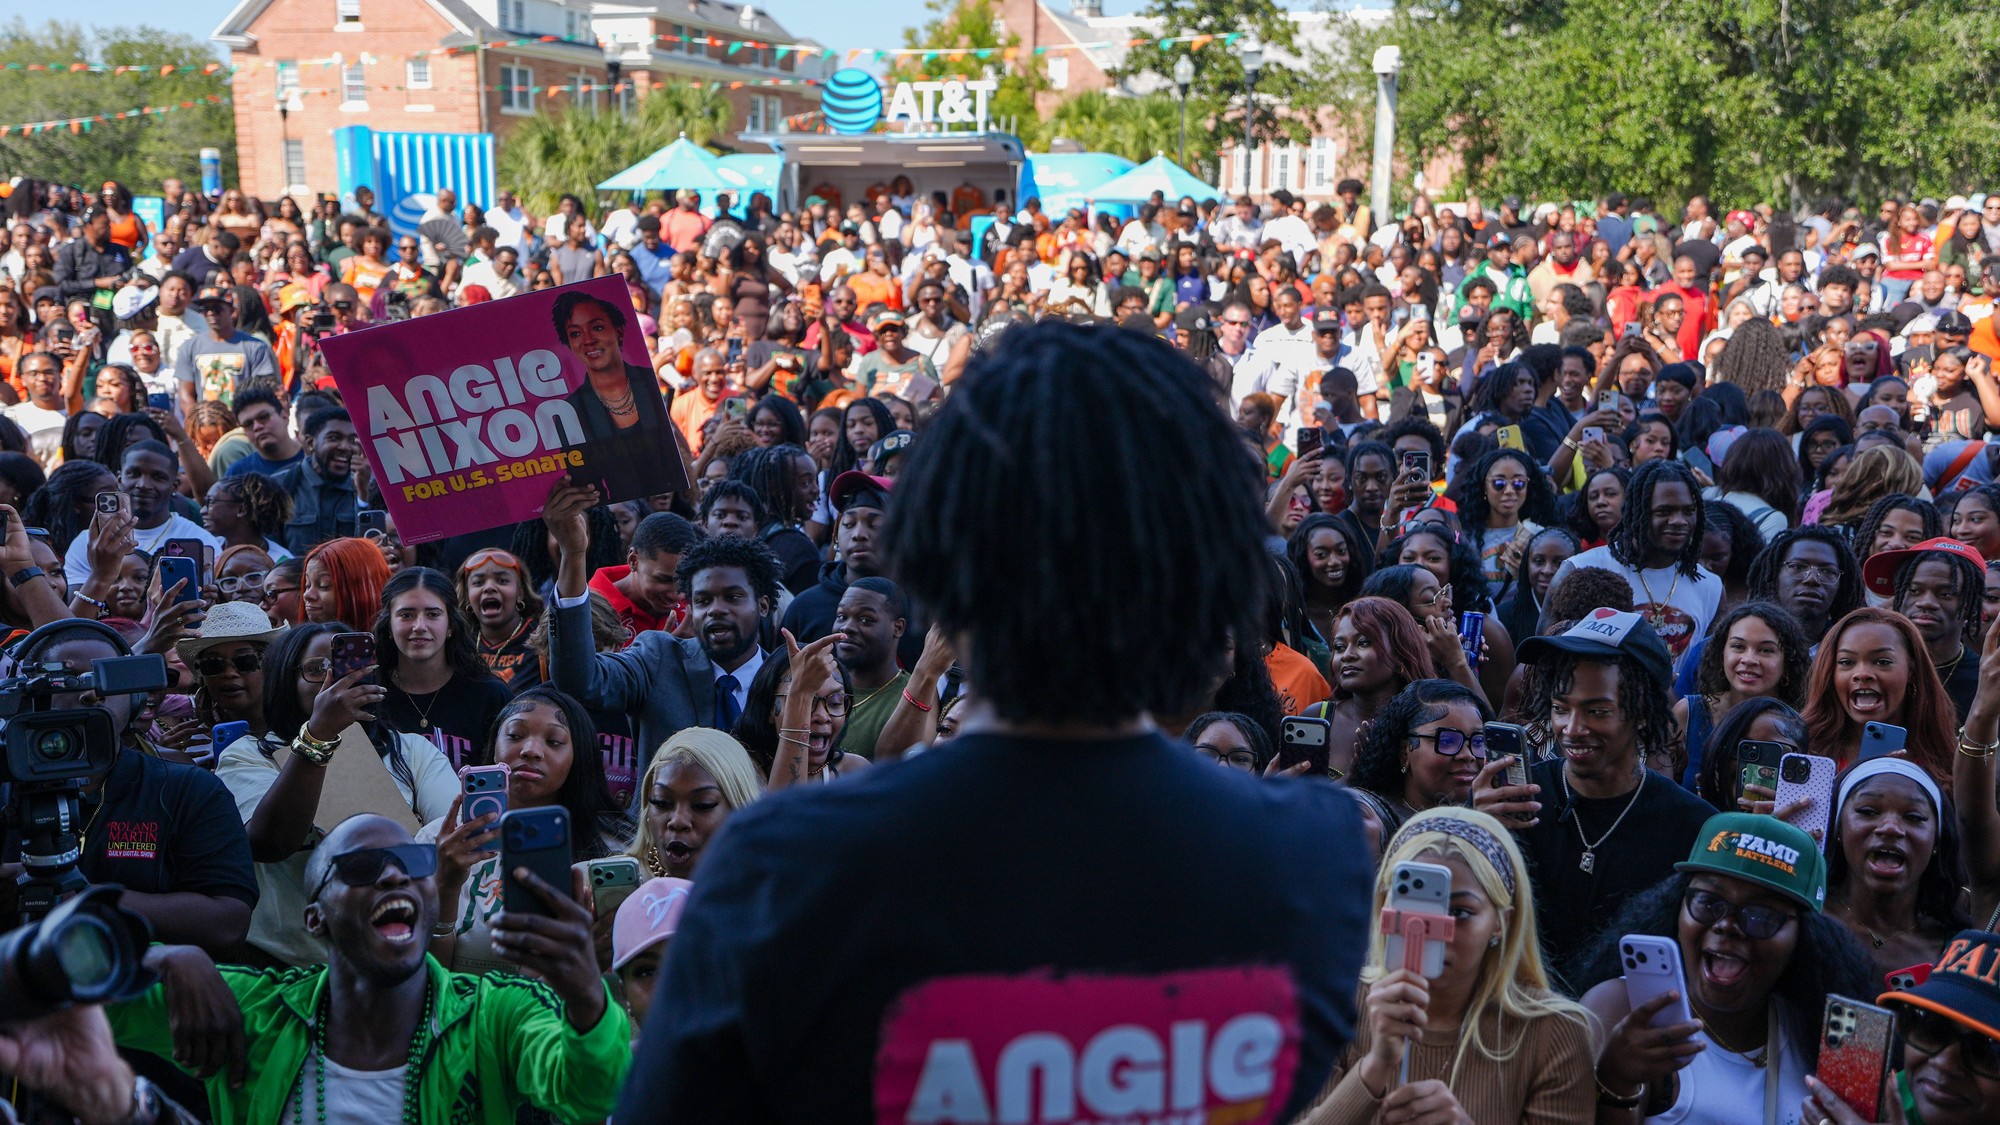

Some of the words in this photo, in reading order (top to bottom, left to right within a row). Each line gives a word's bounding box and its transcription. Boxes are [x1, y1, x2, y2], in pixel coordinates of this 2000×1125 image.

[886, 80, 997, 123] AT&T
[402, 479, 448, 503] FOR
[449, 470, 495, 492] U.S.
[107, 841, 157, 851] UNFILTERED
[109, 831, 158, 842] MARTIN
[1737, 833, 1800, 865] FAMU
